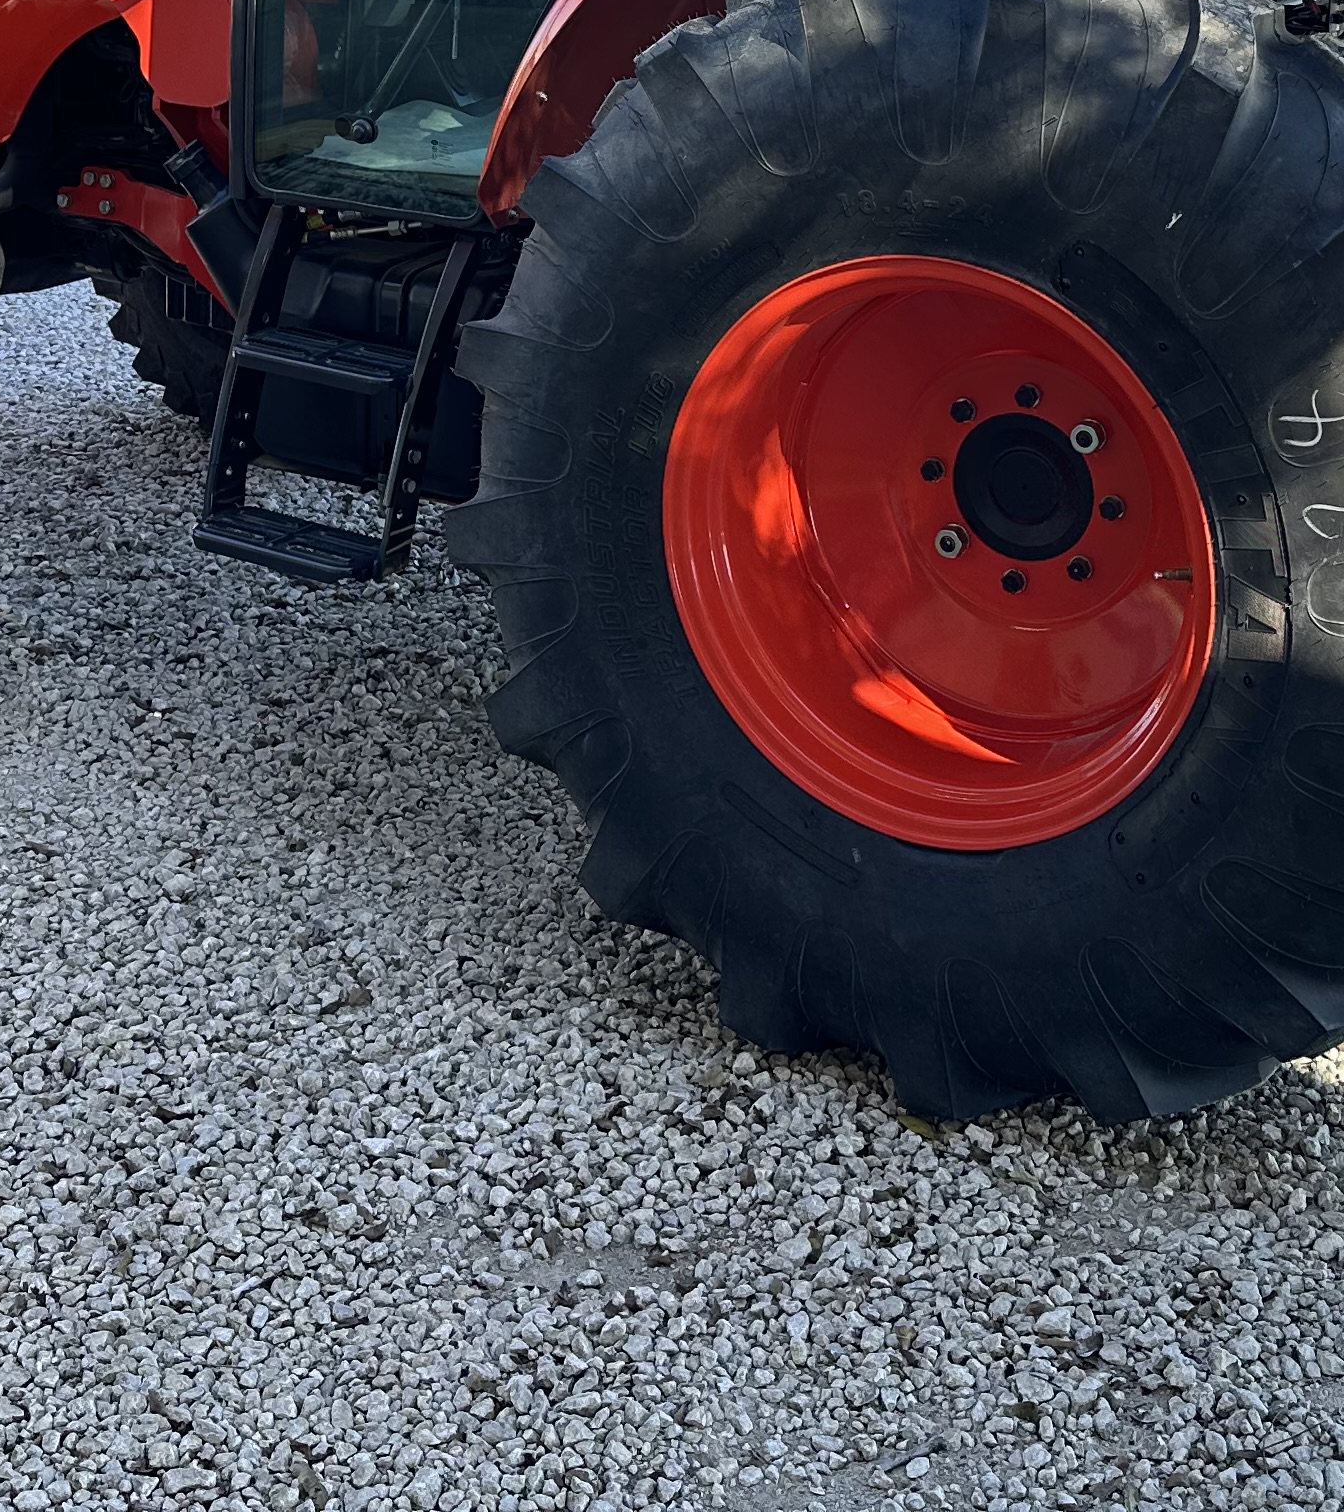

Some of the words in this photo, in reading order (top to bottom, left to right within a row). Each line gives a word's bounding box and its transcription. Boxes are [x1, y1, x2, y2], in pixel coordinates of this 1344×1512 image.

[836, 189, 994, 227] 18.4-24
[628, 371, 676, 461] LUG
[583, 406, 645, 680] INDUSTRIAL
[622, 487, 700, 709] TRACTOR
